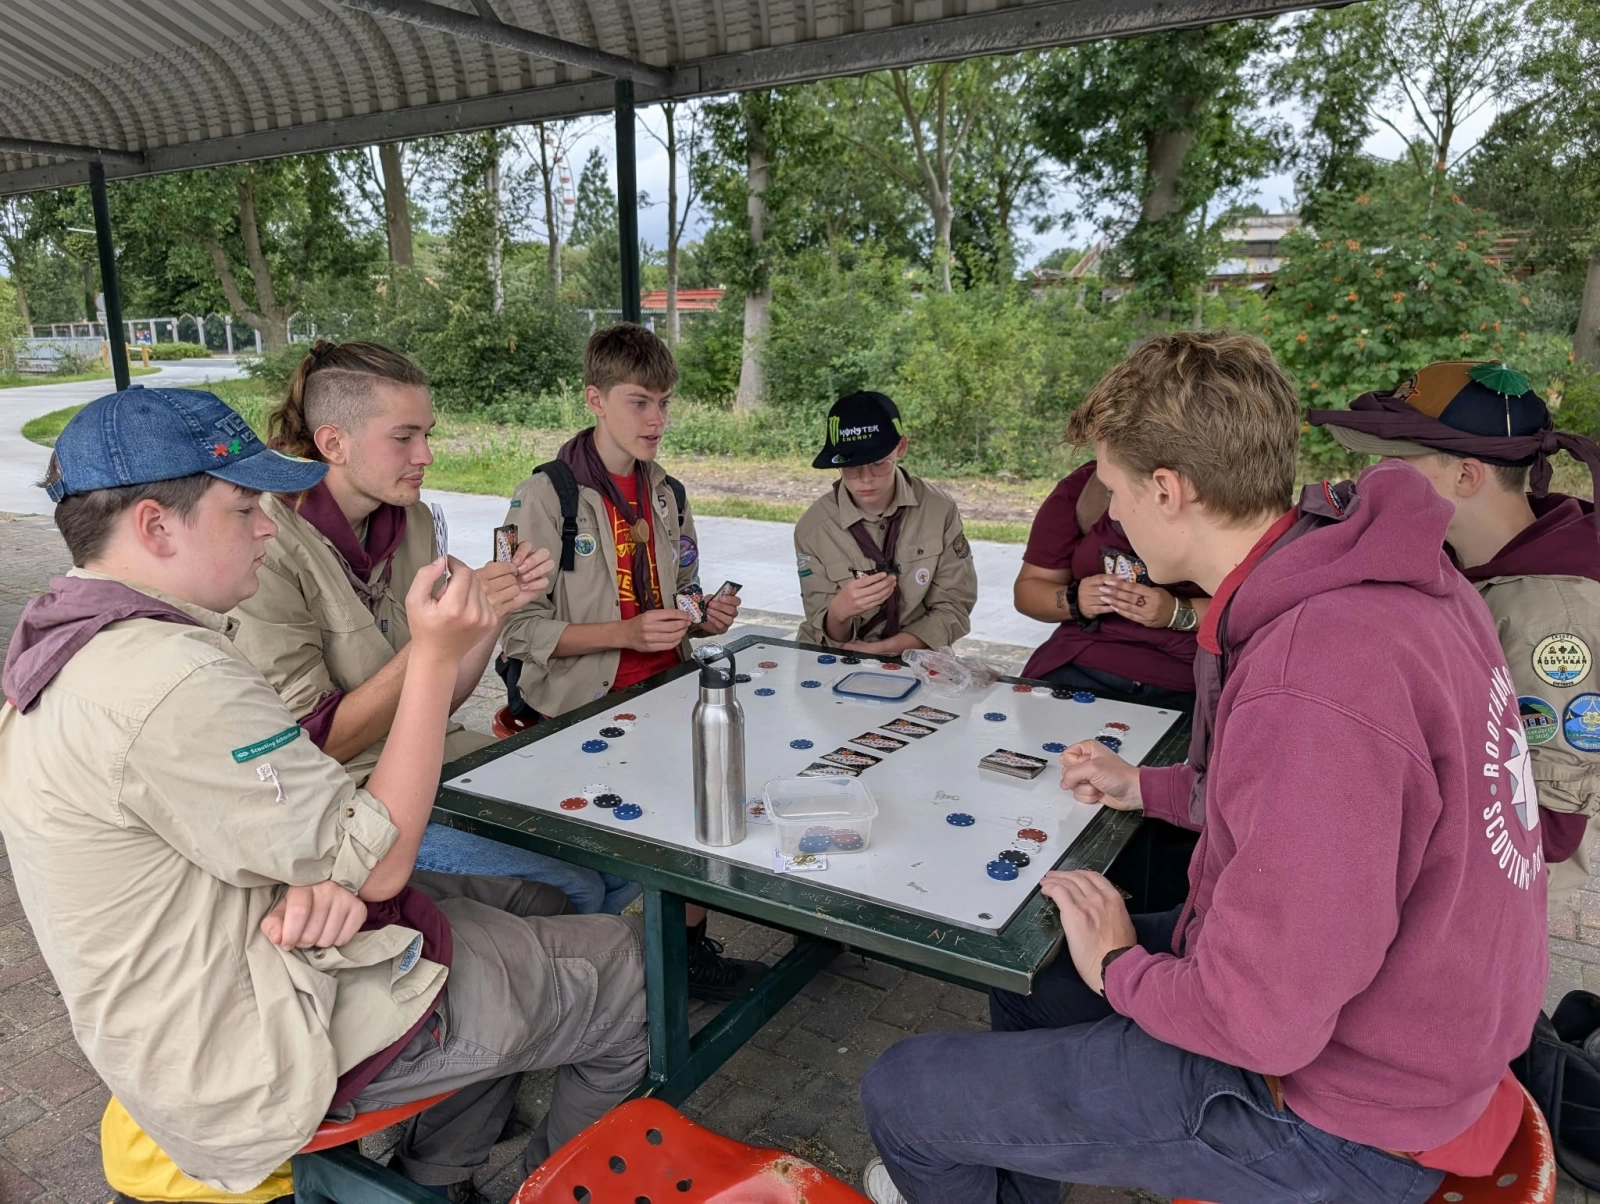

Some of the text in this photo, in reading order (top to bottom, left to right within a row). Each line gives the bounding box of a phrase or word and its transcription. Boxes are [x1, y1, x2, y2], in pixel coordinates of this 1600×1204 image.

[840, 425, 880, 437] MONSTER
[842, 434, 873, 442] ENERGY
[250, 741, 276, 754] Scouting
[1483, 801, 1530, 891] SCOUTING
